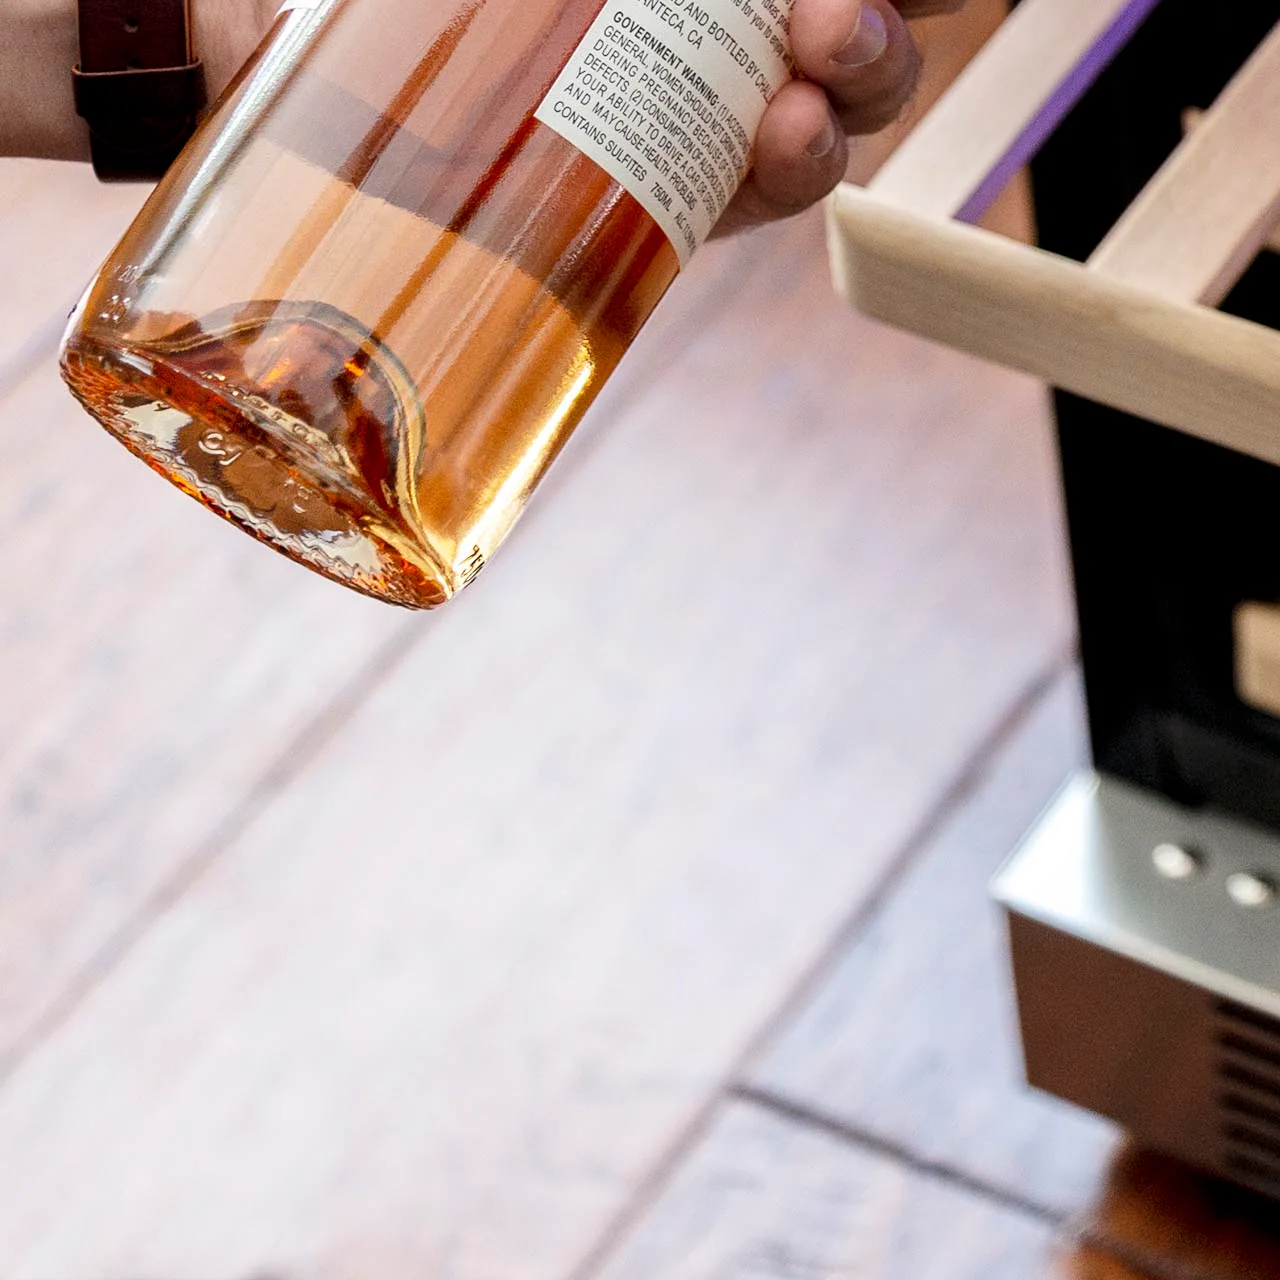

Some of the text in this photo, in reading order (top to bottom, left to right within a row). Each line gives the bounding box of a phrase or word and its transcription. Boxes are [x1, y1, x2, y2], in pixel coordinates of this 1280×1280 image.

[613, 11, 682, 70] GOVERNMENT
[680, 64, 719, 109] WARNING:
[716, 103, 730, 121] (1)
[683, 1, 710, 27] AND
[707, 21, 749, 67] BOTTLED
[745, 60, 759, 78] BY
[754, 73, 775, 104] CHALL
[686, 29, 704, 50] CA
[741, 0, 754, 17] for
[750, 13, 766, 31] you
[763, 24, 773, 38] to
[564, 82, 591, 106] AND
[592, 101, 618, 125] MAY
[614, 119, 646, 151] CAUSE
[641, 143, 672, 176] HEALTH
[575, 67, 608, 97] YOUR
[606, 92, 647, 127] ABILITY
[644, 122, 660, 141] TO
[657, 135, 684, 165] DRIVE
[679, 160, 689, 172] A
[685, 166, 701, 187] CAR
[583, 53, 630, 94] DEFECTS.
[629, 88, 644, 106] (2)
[642, 98, 695, 154] CONSUMPTION
[691, 147, 704, 162] OF
[593, 38, 639, 78] DURING
[638, 72, 695, 128] PREGNANCY
[692, 123, 723, 165] BECAUSE
[603, 25, 650, 68] GENERAL,
[651, 61, 686, 96] WOMEN
[682, 90, 713, 124] SHOULD
[709, 118, 724, 138] NOT
[553, 100, 607, 145] CONTAINS
[604, 139, 648, 182] SULFITES
[650, 182, 673, 212] 750ML
